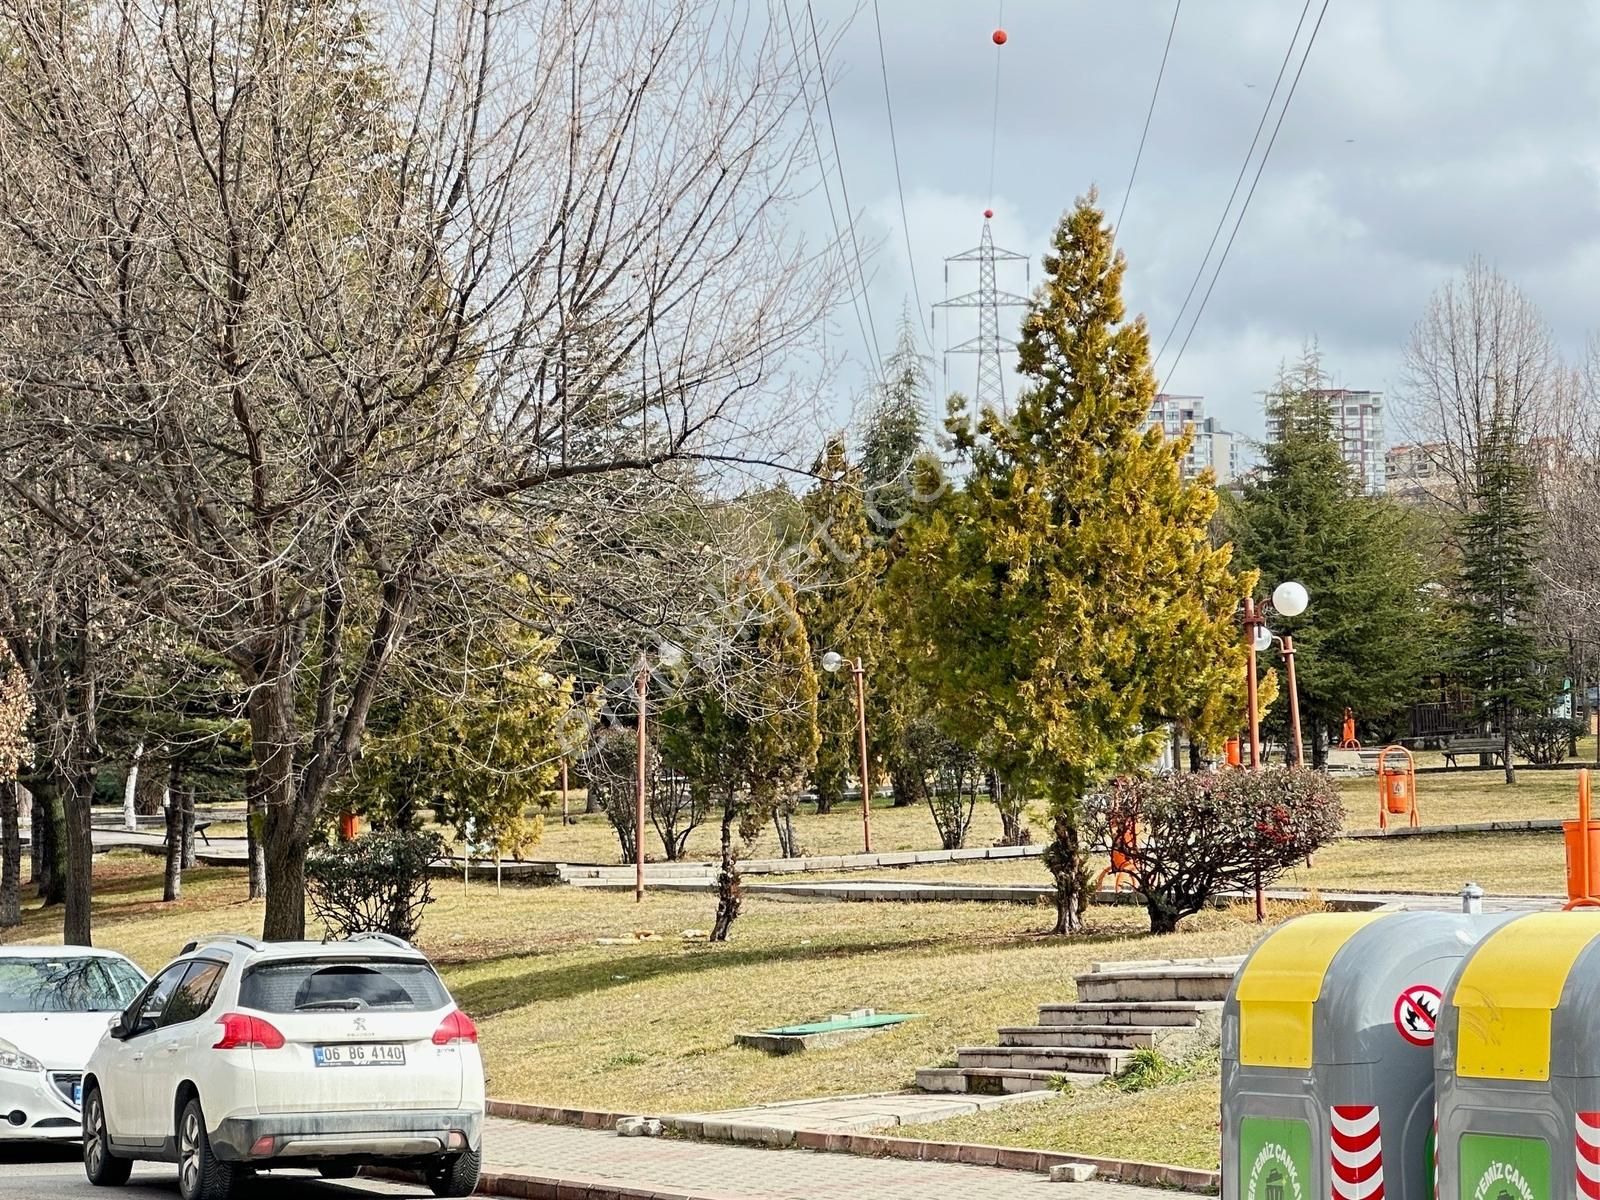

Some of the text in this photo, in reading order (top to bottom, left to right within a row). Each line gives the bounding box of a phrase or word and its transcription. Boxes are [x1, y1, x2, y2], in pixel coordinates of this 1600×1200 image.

[324, 1046, 401, 1060] 06 BG 4140
[1251, 1141, 1275, 1180] TEMİZ
[1474, 1160, 1504, 1200] TEMİZ
